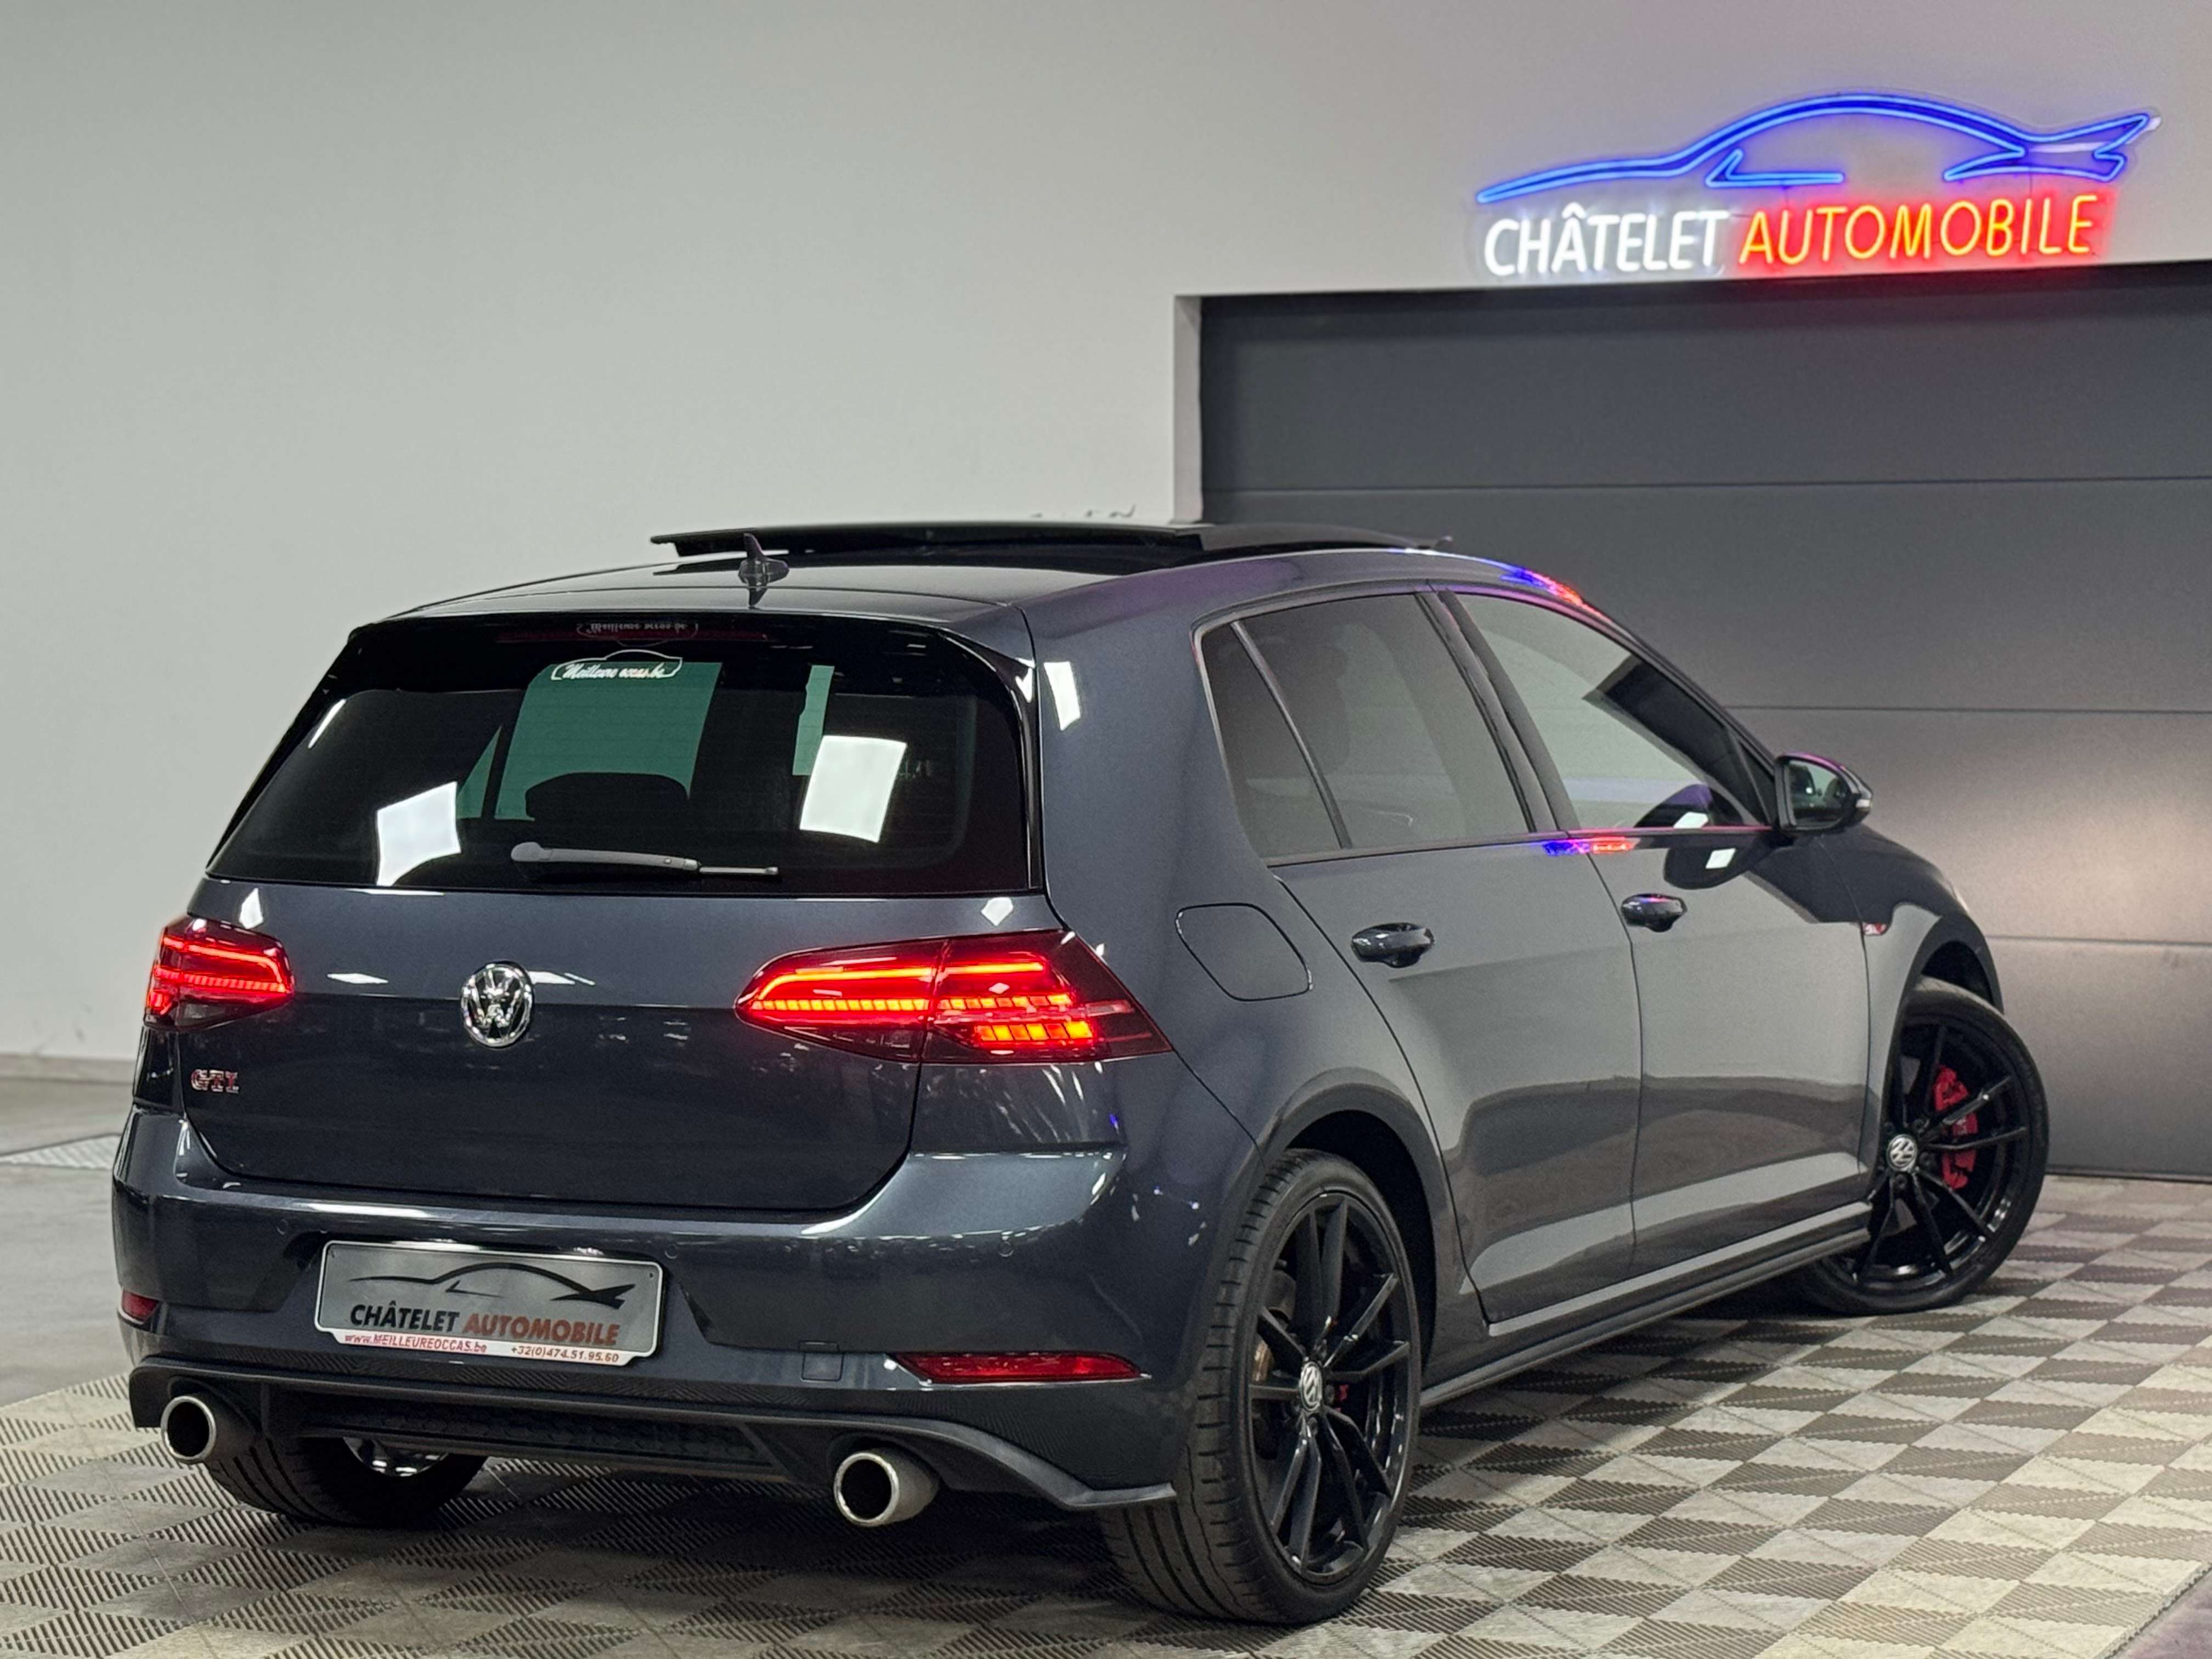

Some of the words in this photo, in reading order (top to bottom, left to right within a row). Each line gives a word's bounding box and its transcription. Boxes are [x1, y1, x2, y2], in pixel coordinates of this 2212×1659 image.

[1483, 202, 1728, 276] CHÂTELET
[1740, 195, 2097, 264] AUTOMOBILE
[190, 1069, 240, 1094] GTI
[350, 1301, 460, 1332] CHÂTELET
[462, 1313, 620, 1345] AUTOMOBILE
[345, 1334, 488, 1353] www.MEILLEUREOCCAS.be
